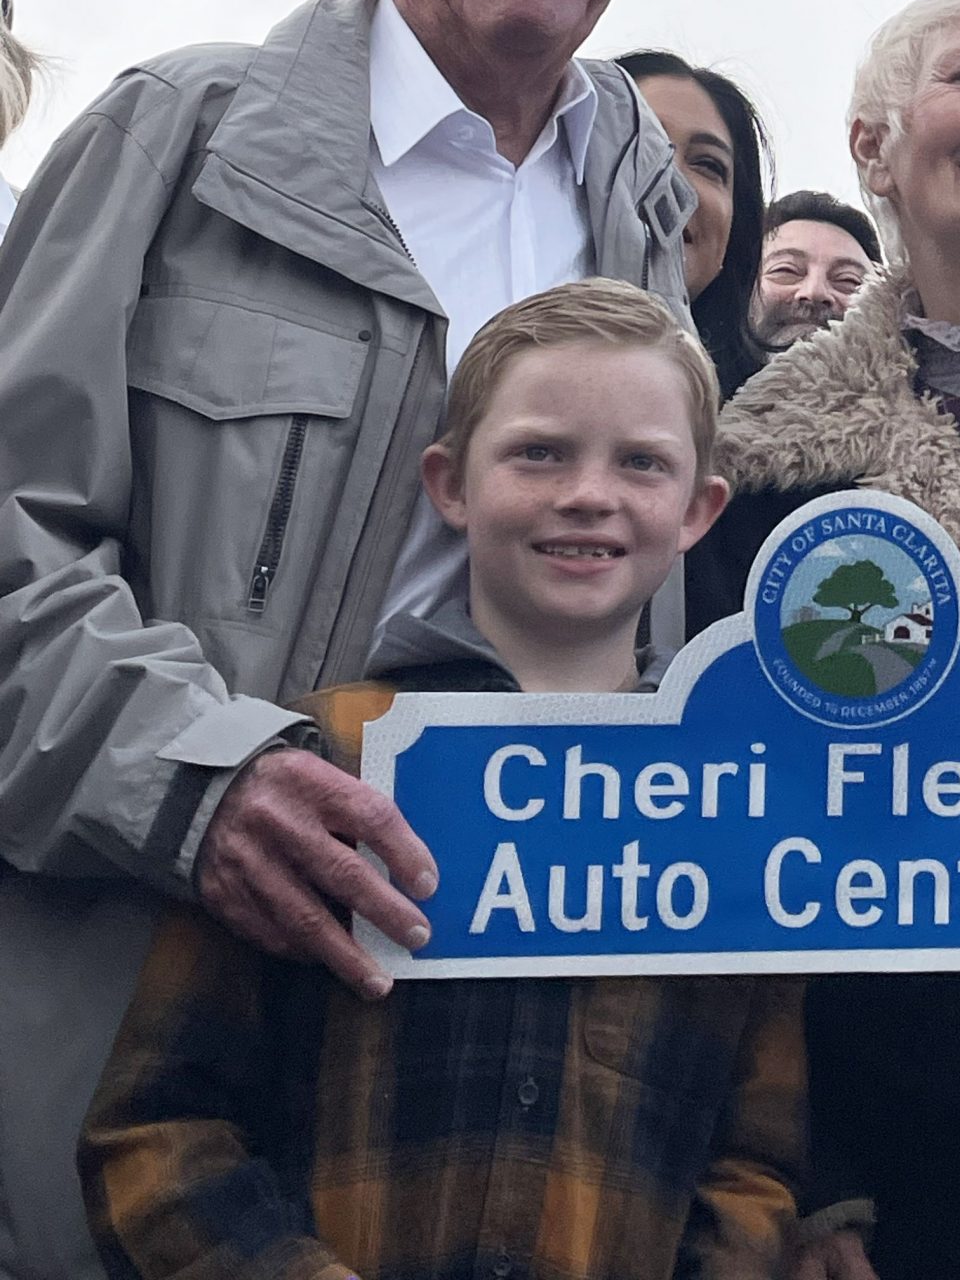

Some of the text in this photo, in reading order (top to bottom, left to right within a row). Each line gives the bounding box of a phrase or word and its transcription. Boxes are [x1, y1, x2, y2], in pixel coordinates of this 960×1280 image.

[762, 513, 951, 605] CITY OF SANTA CLARITA
[773, 658, 821, 708] FOUNDED
[483, 742, 766, 821] Cheri
[469, 840, 709, 934] Auto
